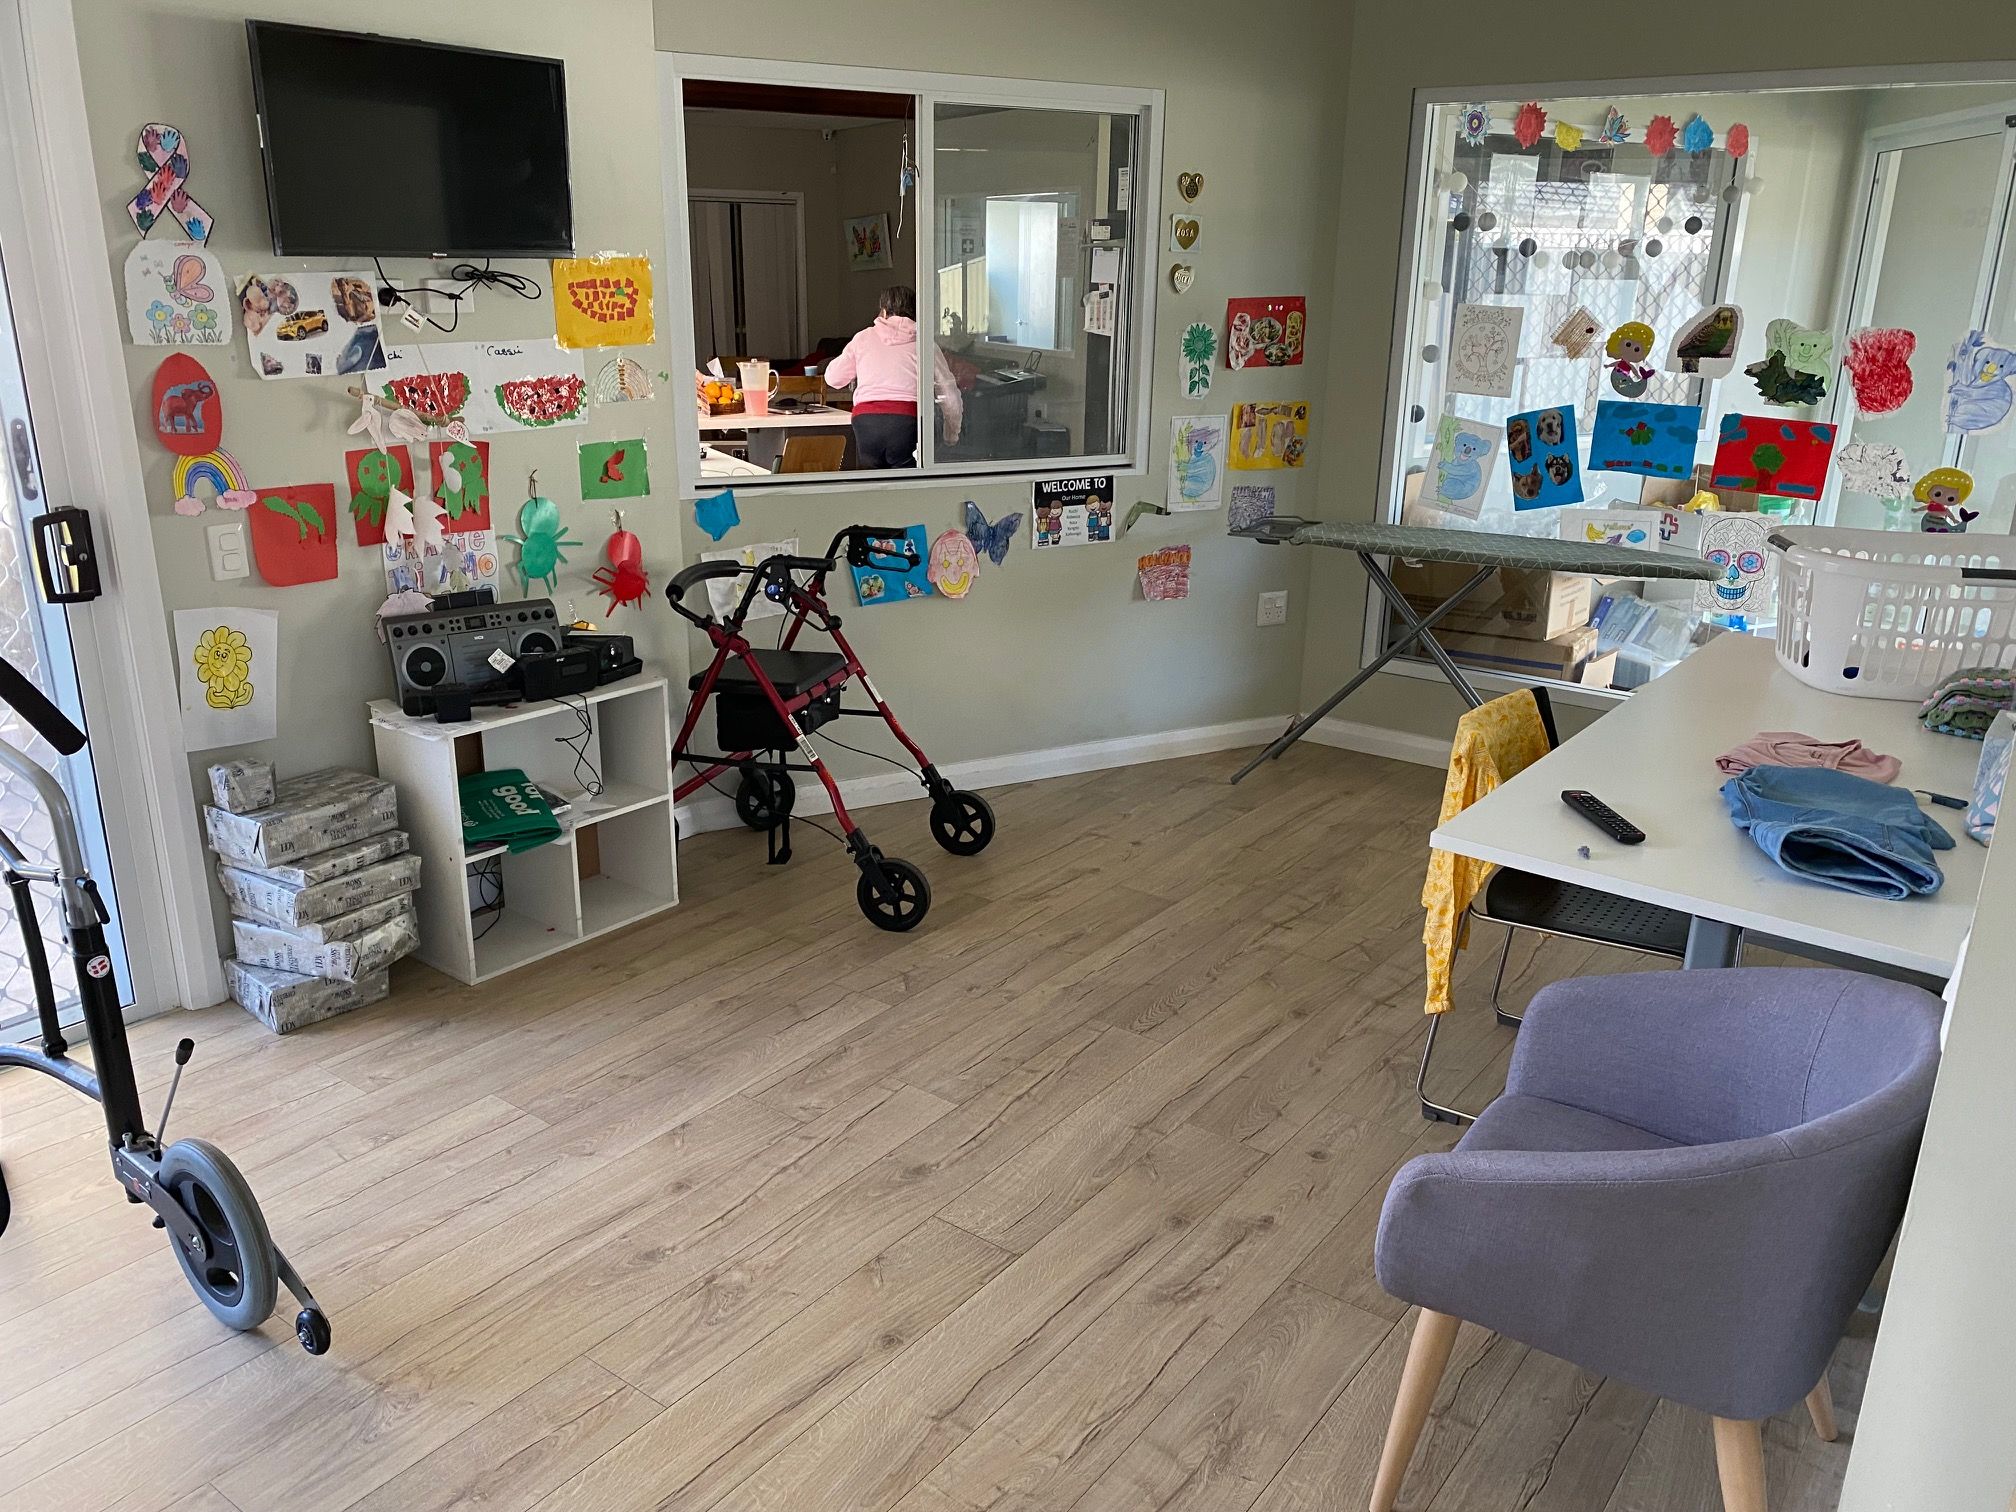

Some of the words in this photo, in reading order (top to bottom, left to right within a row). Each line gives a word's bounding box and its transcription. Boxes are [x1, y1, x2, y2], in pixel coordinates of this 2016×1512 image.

[1042, 479, 1091, 493] WELCOME
[1093, 477, 1107, 489] TO
[492, 785, 541, 816] good
